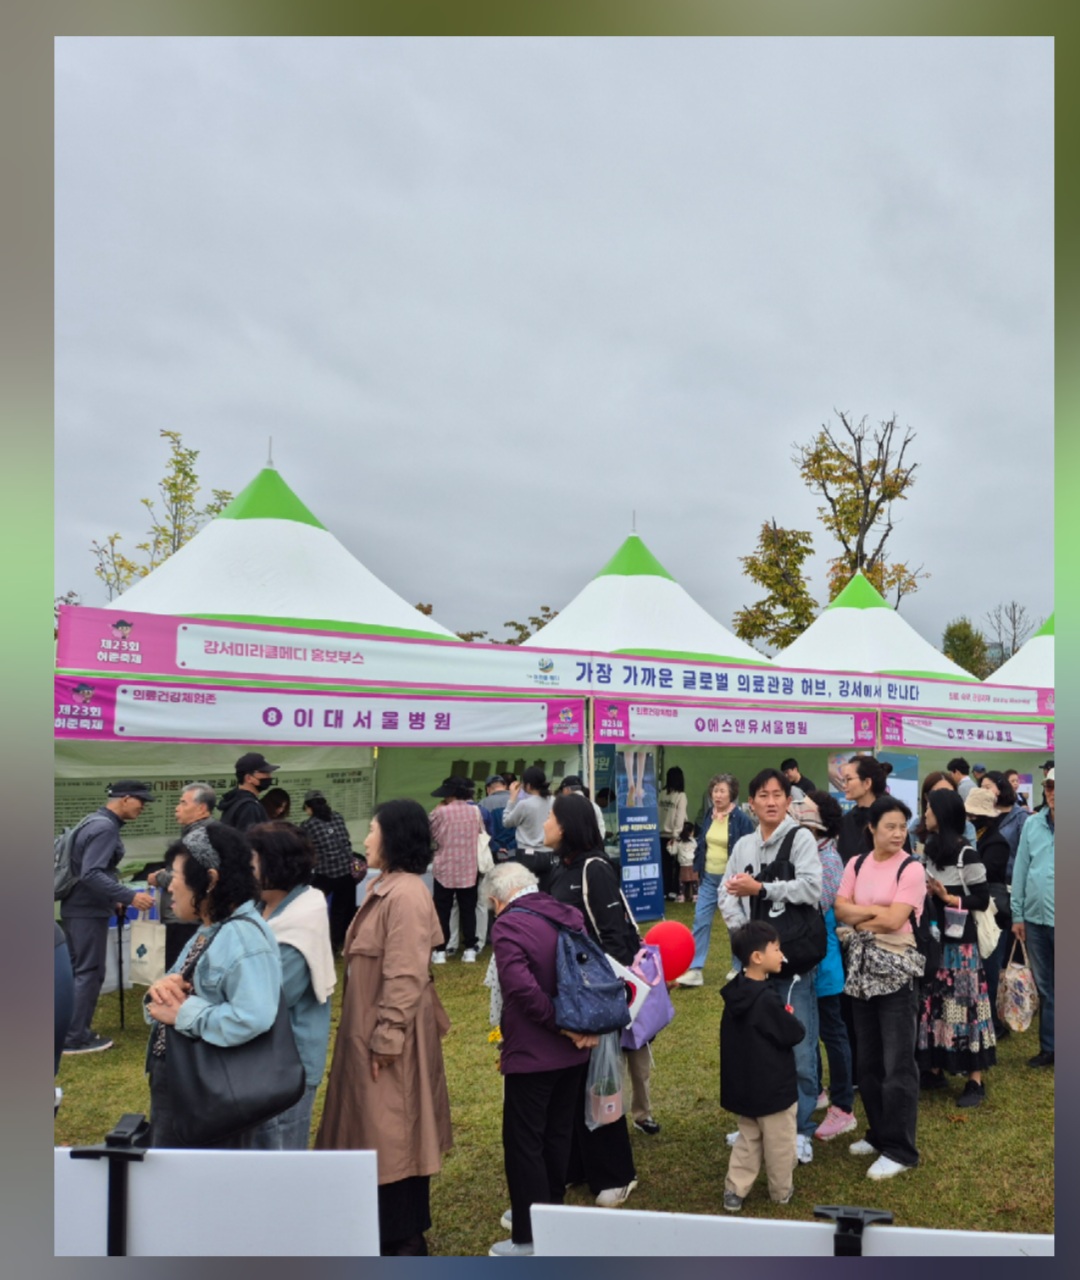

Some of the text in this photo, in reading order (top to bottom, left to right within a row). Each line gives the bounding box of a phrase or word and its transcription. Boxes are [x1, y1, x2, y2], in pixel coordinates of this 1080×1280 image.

[100, 638, 140, 652] 제23회
[203, 639, 365, 665] 강서미라클메디 홍보부스
[575, 662, 613, 685] 가장
[622, 665, 674, 688] 가까운
[682, 669, 729, 692] 글로벌
[737, 673, 795, 696] 의료관광
[801, 678, 832, 698] 허브,
[838, 680, 883, 699] 강서에서
[887, 682, 920, 701] 만나다
[132, 689, 217, 705] 의료건강체험존
[57, 704, 102, 717] 제23회
[293, 706, 452, 731] 이대서울병원
